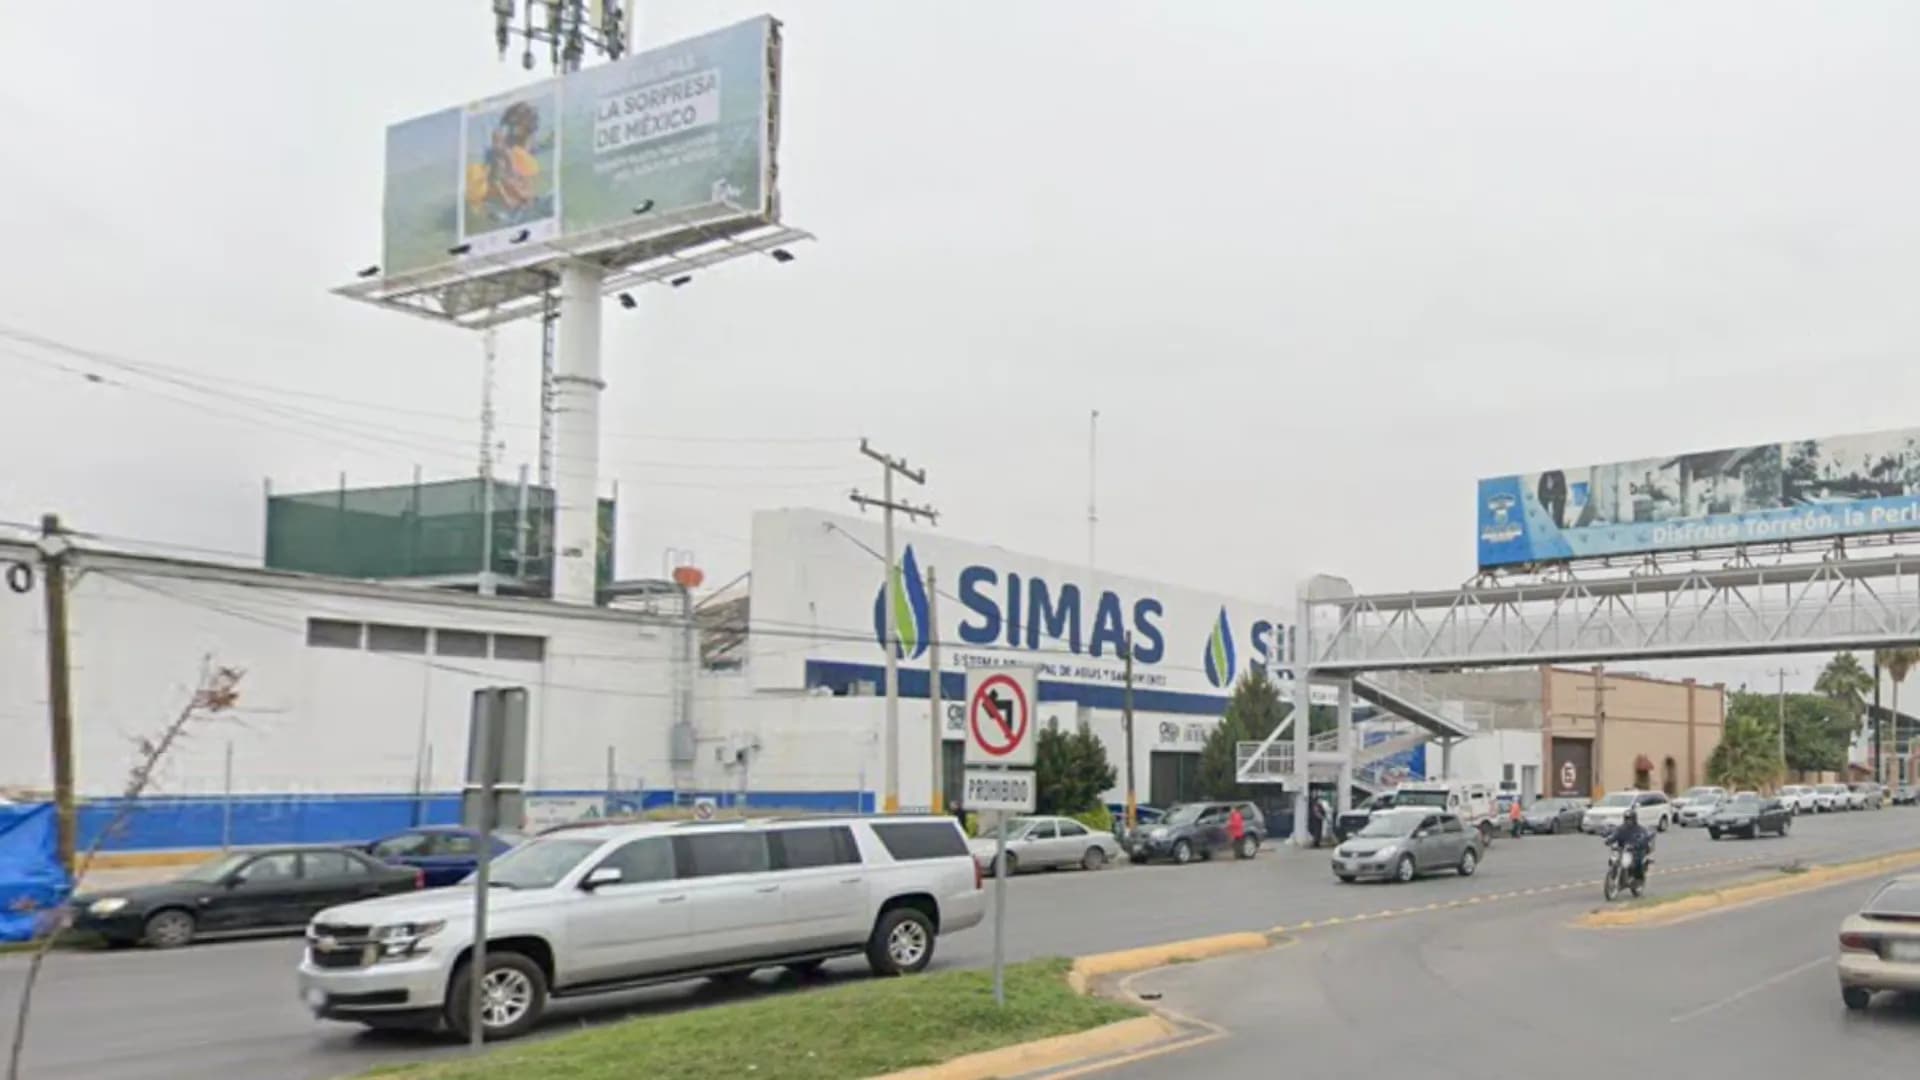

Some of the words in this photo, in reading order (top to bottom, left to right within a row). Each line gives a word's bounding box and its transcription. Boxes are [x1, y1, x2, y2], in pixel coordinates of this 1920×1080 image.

[598, 100, 620, 120] LA
[624, 73, 717, 115] SORPRESA
[598, 126, 620, 148] DE
[625, 105, 697, 141] MÉXICO
[1653, 520, 1738, 544] Disfruta
[1844, 508, 1865, 527] la
[958, 565, 1164, 664] SIMAS
[968, 778, 1029, 803] PROHIBIDO
